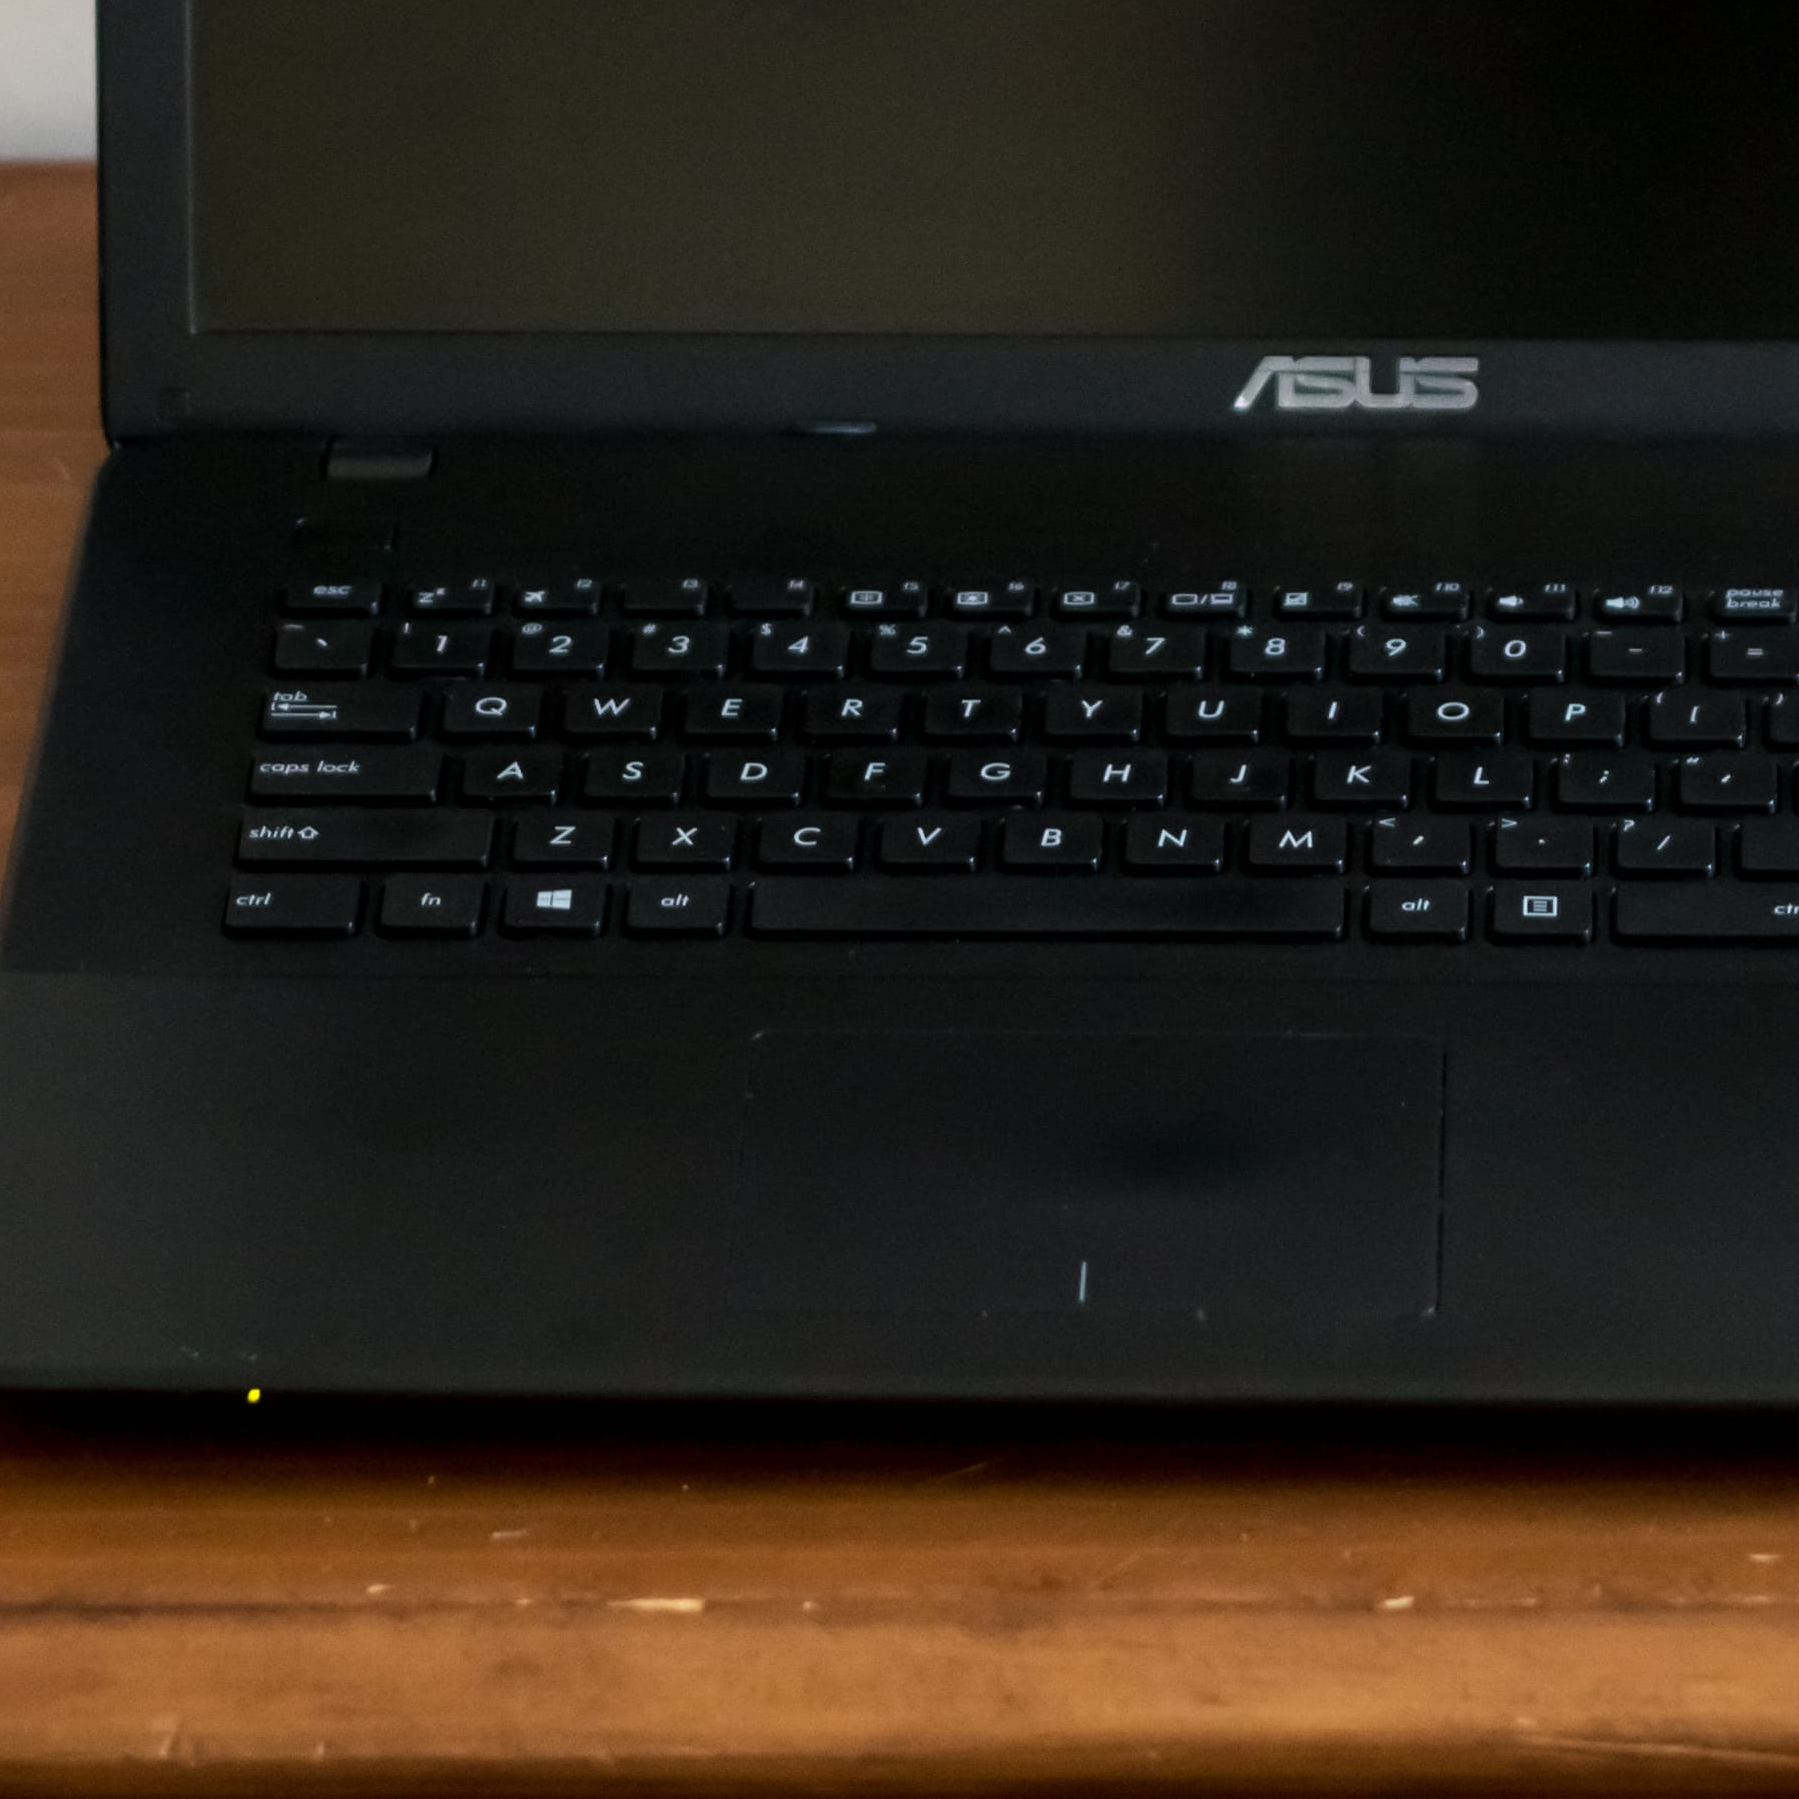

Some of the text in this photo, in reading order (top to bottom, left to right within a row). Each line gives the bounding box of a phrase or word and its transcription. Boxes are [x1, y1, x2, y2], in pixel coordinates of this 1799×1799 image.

[1233, 356, 1479, 408] ASUS
[313, 585, 351, 596] esc
[1725, 588, 1784, 599] pause
[1725, 598, 1782, 609] break
[436, 635, 448, 653] 1
[549, 635, 573, 655] 2
[667, 635, 691, 654] 3
[788, 636, 809, 654] 4
[906, 636, 928, 655] 5
[1024, 636, 1047, 656] 6
[1145, 637, 1166, 655] 7
[1264, 637, 1286, 657] 8
[1385, 638, 1407, 657] 9
[1503, 639, 1527, 658] 0
[272, 690, 308, 703] tab
[474, 696, 508, 716] Q
[593, 698, 630, 716] W
[720, 698, 743, 717] E
[841, 698, 863, 717] R
[961, 699, 981, 718] T
[1081, 700, 1103, 718] Y
[1198, 700, 1225, 719] U
[1328, 701, 1338, 720] I
[1436, 701, 1470, 721] O
[1564, 703, 1586, 722] P
[259, 760, 360, 776] caps lock
[496, 761, 524, 780] A
[622, 761, 644, 781] S
[740, 762, 768, 781] D
[864, 762, 886, 781] F
[980, 762, 1011, 781] G
[1103, 763, 1131, 783] H
[1230, 764, 1247, 784] J
[1346, 765, 1371, 784] K
[1473, 766, 1490, 785] L
[249, 825, 295, 839] shift
[549, 825, 576, 845] Z
[671, 827, 698, 846] X
[793, 826, 821, 846] C
[917, 827, 942, 846] V
[1040, 828, 1062, 847] B
[1157, 829, 1188, 848] N
[1278, 830, 1313, 849] M
[235, 892, 272, 906] ctrl
[420, 892, 442, 906] fn
[660, 893, 690, 907] alt
[1401, 898, 1430, 912] alt
